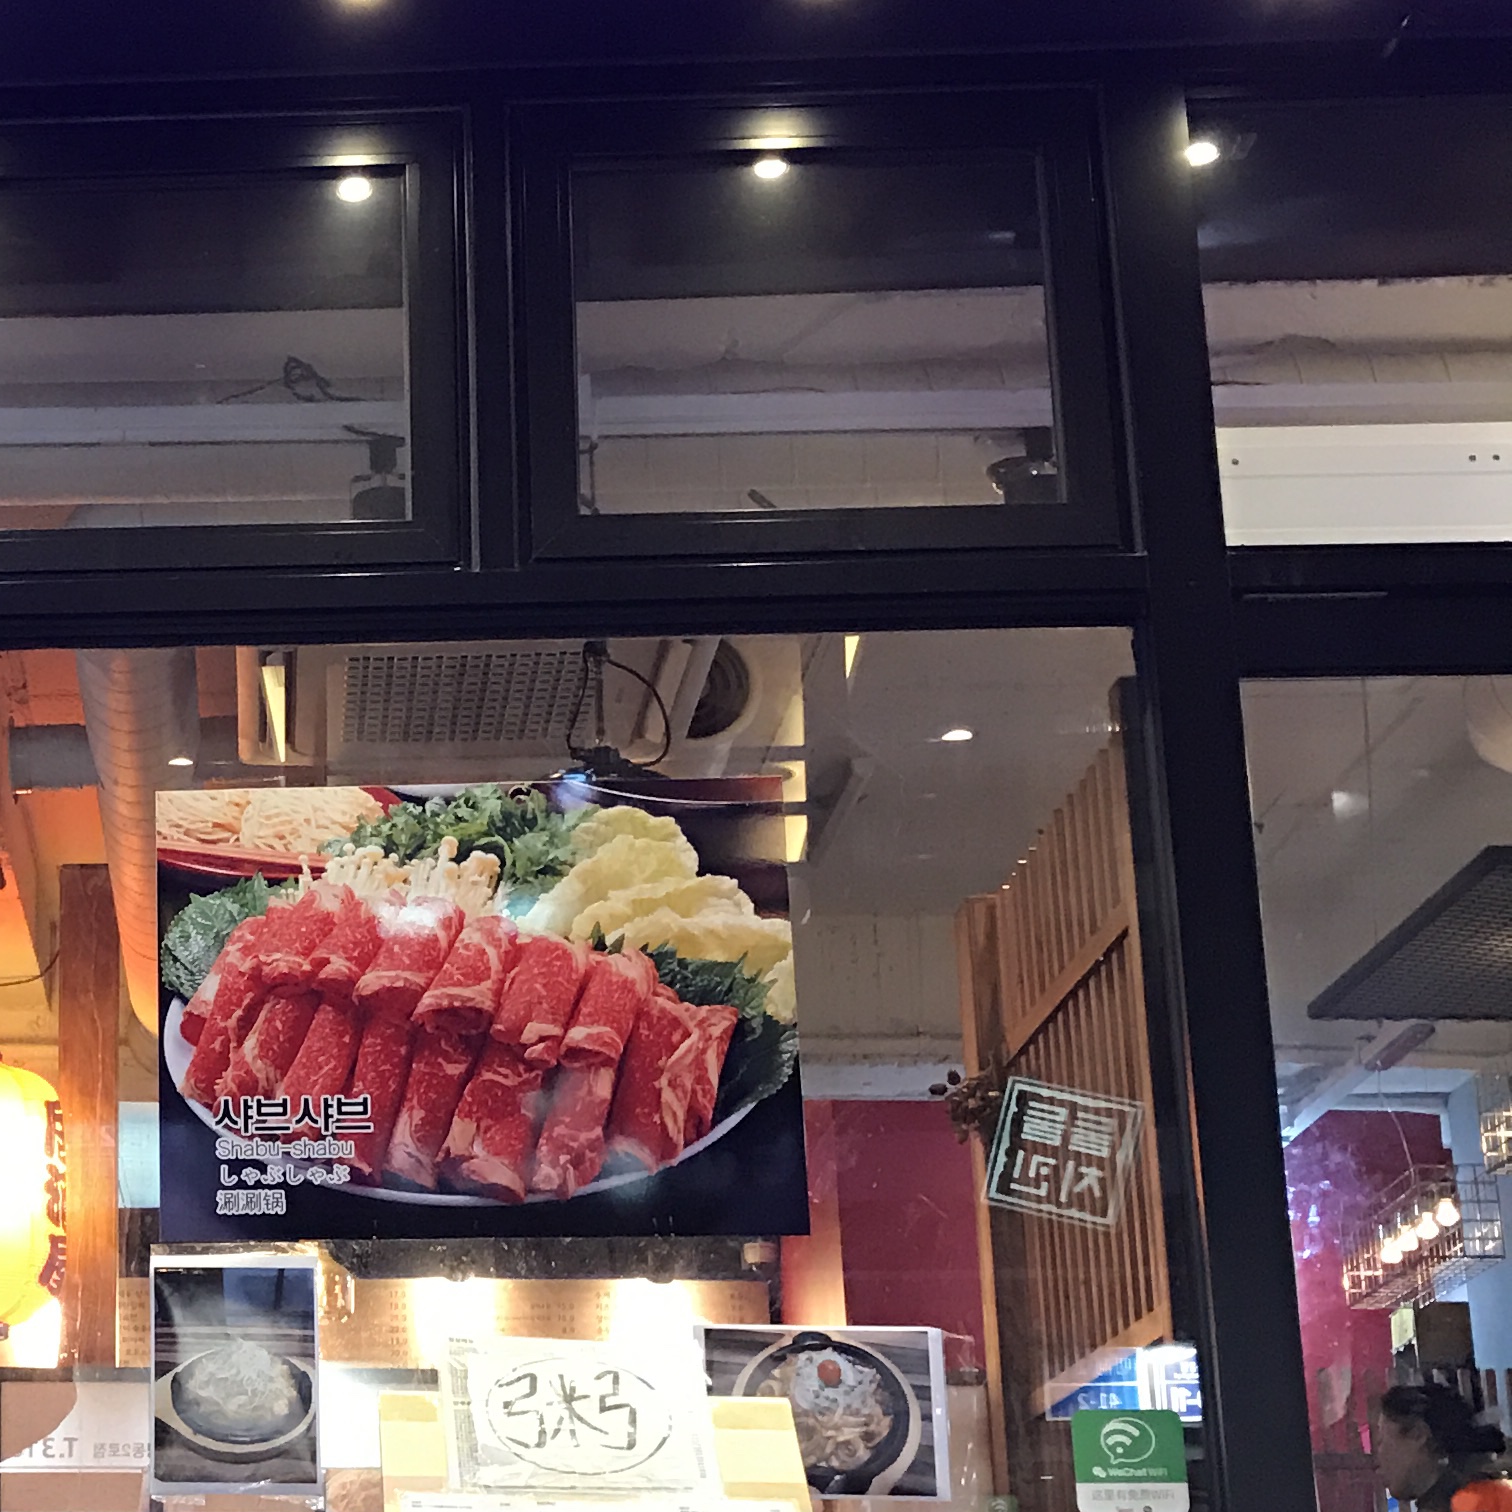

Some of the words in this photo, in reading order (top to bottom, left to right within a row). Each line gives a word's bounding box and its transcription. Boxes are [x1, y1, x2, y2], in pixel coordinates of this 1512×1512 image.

[215, 1096, 373, 1134] 샤브샤브
[217, 1138, 354, 1158] Shabu-shabu
[220, 1165, 351, 1185] しゃぶしゃぶ
